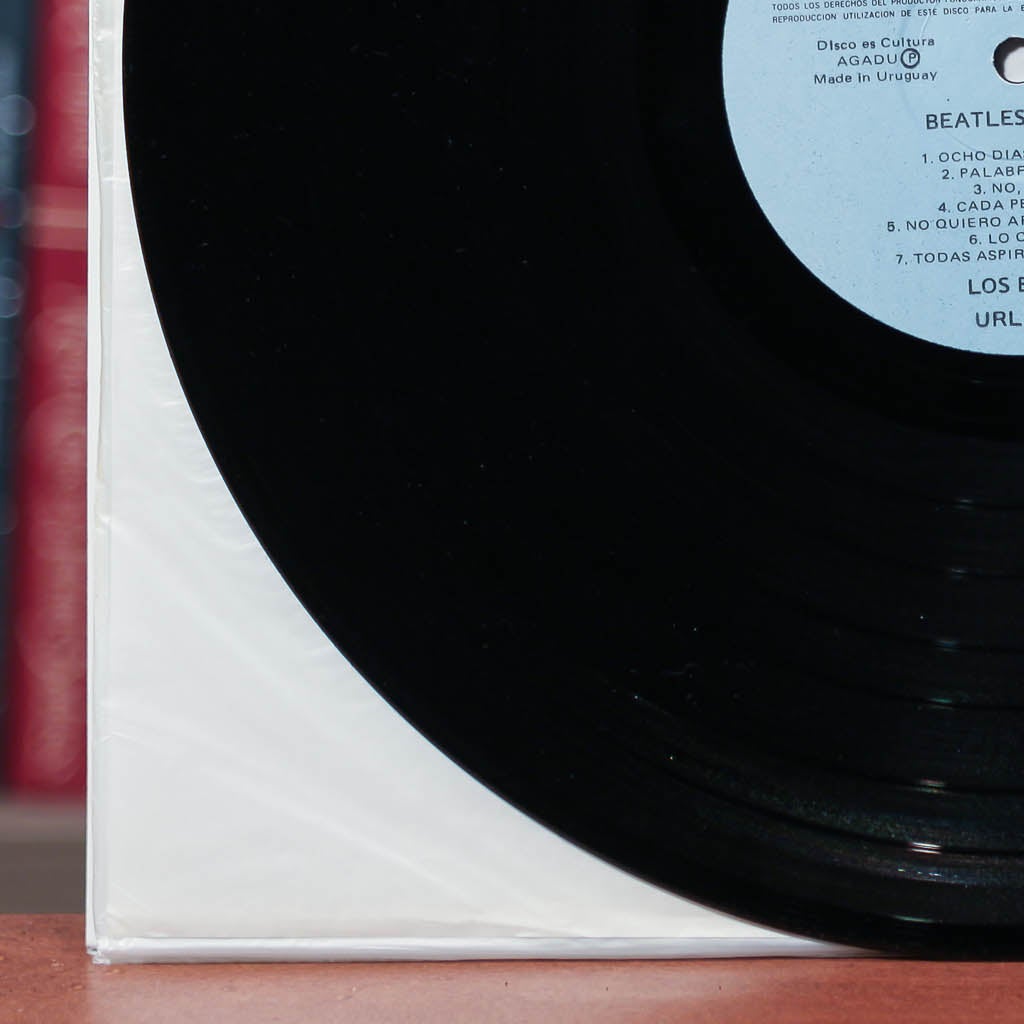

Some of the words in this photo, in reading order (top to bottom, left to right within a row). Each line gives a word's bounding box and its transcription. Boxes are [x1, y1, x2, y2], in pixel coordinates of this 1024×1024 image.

[772, 2, 800, 11] TODOS
[804, 1, 820, 9] LOS
[823, 0, 867, 8] DERECHOS
[772, 13, 836, 23] REPRODUCCION
[842, 10, 894, 20] UTILIZACION
[900, 9, 911, 17] DE
[917, 8, 937, 16] ESTE
[942, 6, 968, 15] DISCO
[974, 5, 996, 14] PARA
[1002, 4, 1012, 12] LA
[862, 40, 875, 49] es
[880, 36, 934, 48] Cultura
[837, 54, 898, 67] AGADU
[814, 73, 852, 84] Made
[876, 71, 937, 82] Uruguay
[921, 152, 934, 164] 1.
[938, 150, 986, 162] OCHO
[941, 168, 954, 180] 2.
[973, 183, 986, 195] 3.
[992, 182, 1020, 195] NO,
[937, 201, 950, 213] 4.
[956, 199, 1004, 212] CADA
[887, 221, 900, 234] 5.
[906, 220, 930, 231] NO
[935, 216, 1001, 229] QUIERO
[969, 234, 981, 244] 6.
[988, 232, 1009, 244] LO
[895, 253, 907, 265] 7.
[912, 250, 970, 264] TODAS
[968, 276, 1010, 295] LOS
[975, 310, 1022, 328] URL
